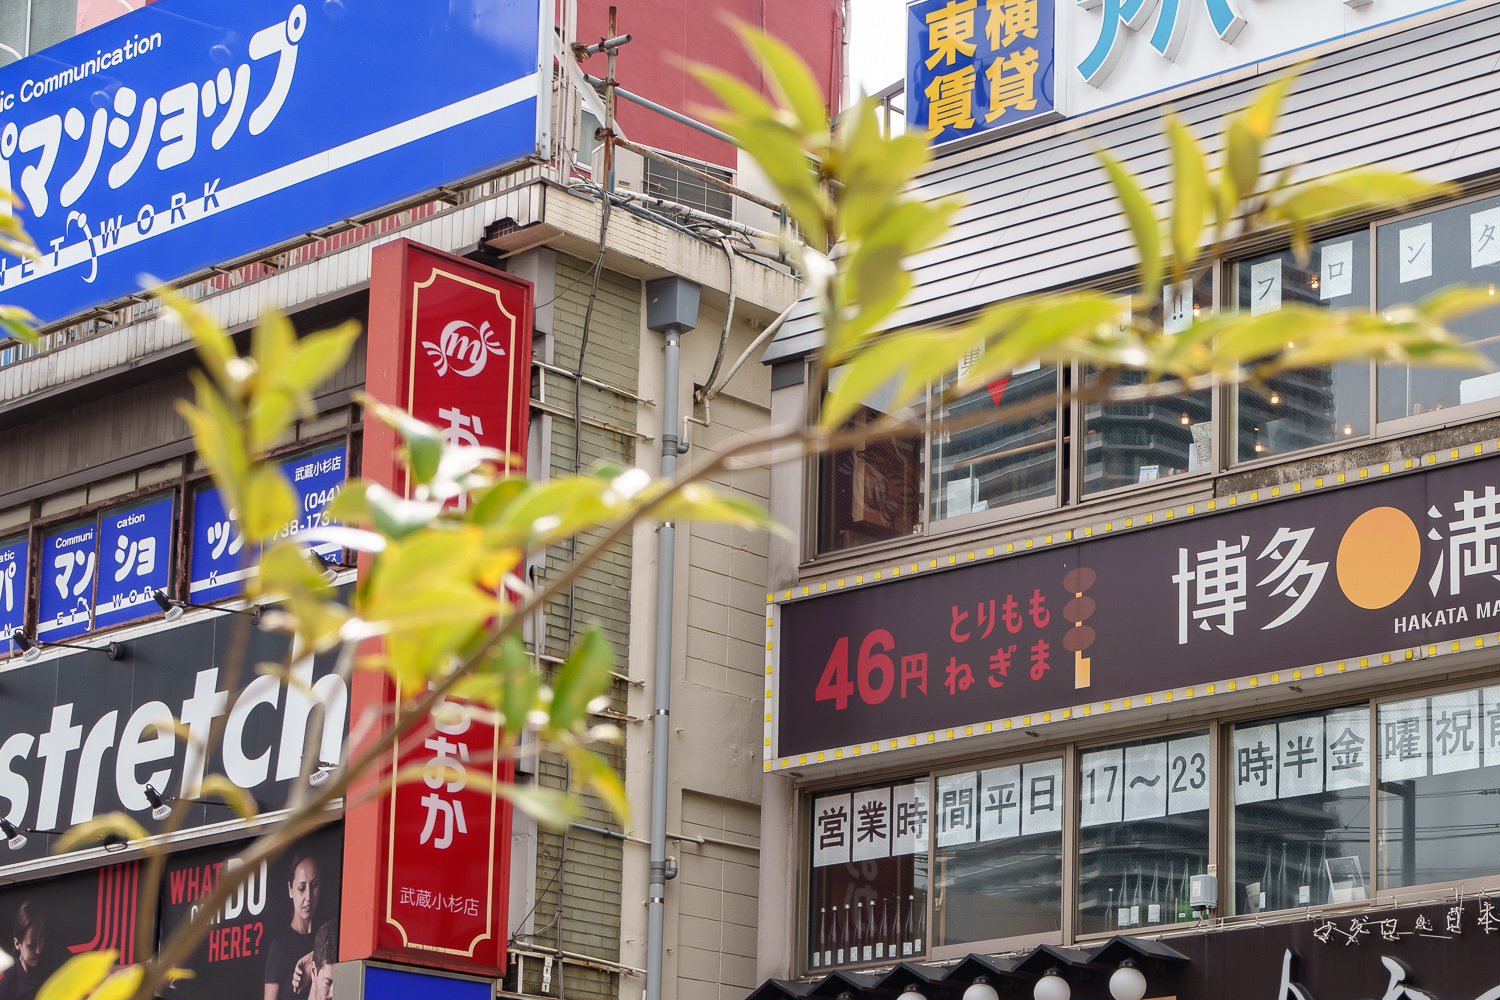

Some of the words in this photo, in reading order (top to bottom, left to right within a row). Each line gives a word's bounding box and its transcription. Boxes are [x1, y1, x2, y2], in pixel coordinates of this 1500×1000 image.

[20, 31, 162, 103] Communication
[923, 46, 1039, 140] 賃貸
[294, 455, 342, 482] 武蔵小杉店
[1170, 524, 1331, 646] 博多
[950, 588, 1052, 643] とりもも
[1393, 608, 1467, 635] HAKATA
[814, 628, 929, 711] 46円
[943, 642, 1051, 697] ねぎま
[0, 630, 349, 841] stretch
[170, 862, 224, 905] WHAT
[400, 885, 481, 918] 武蔵小杉店
[208, 922, 264, 963] HERE?
